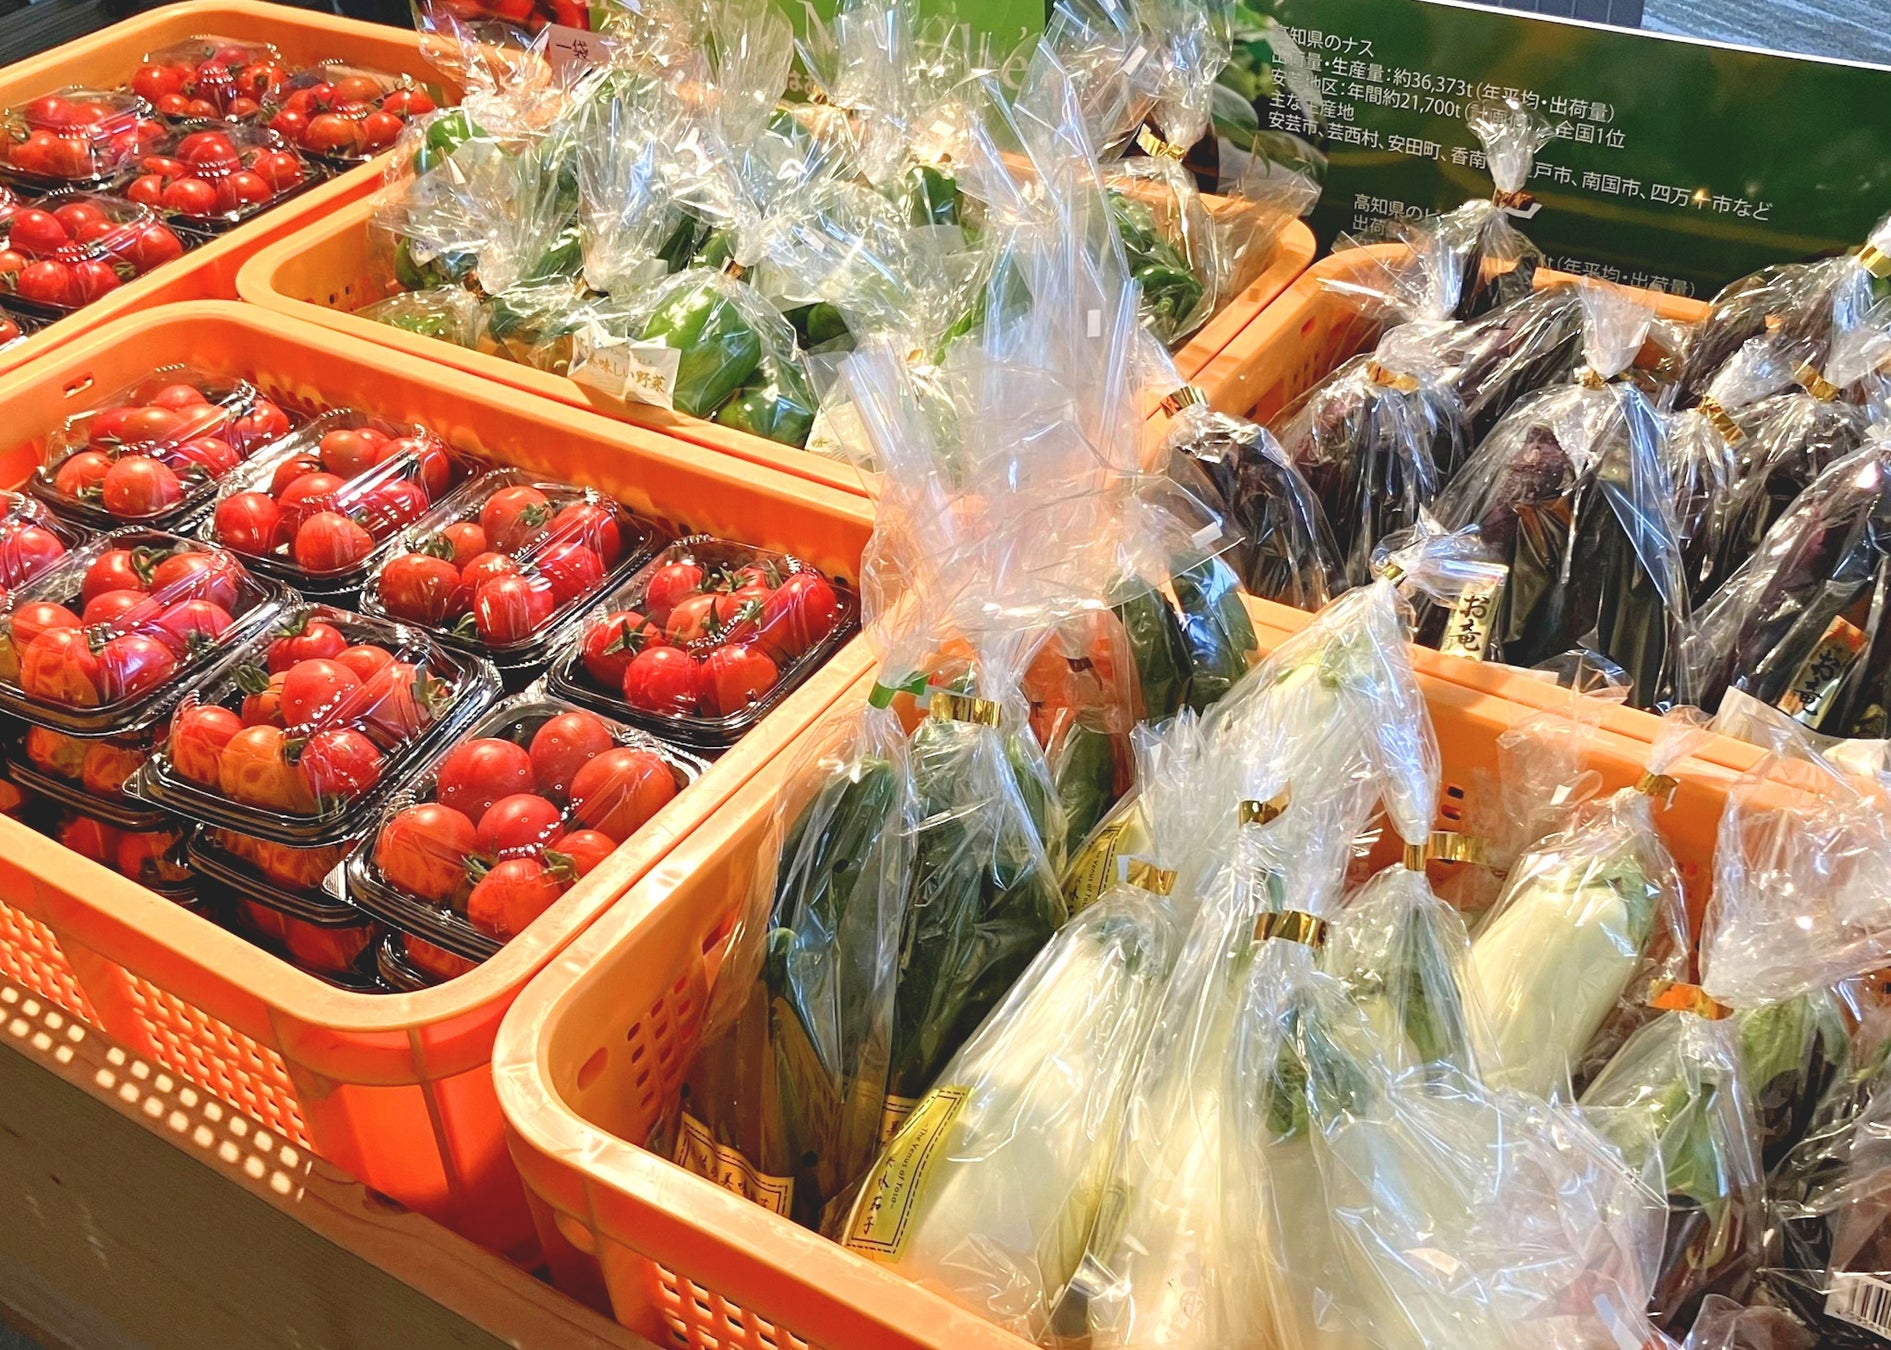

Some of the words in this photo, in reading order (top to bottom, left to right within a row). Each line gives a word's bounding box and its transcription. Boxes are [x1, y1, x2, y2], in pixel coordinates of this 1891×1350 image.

[1277, 25, 1374, 58] 知県のナス
[901, 1143, 919, 1168] Venus
